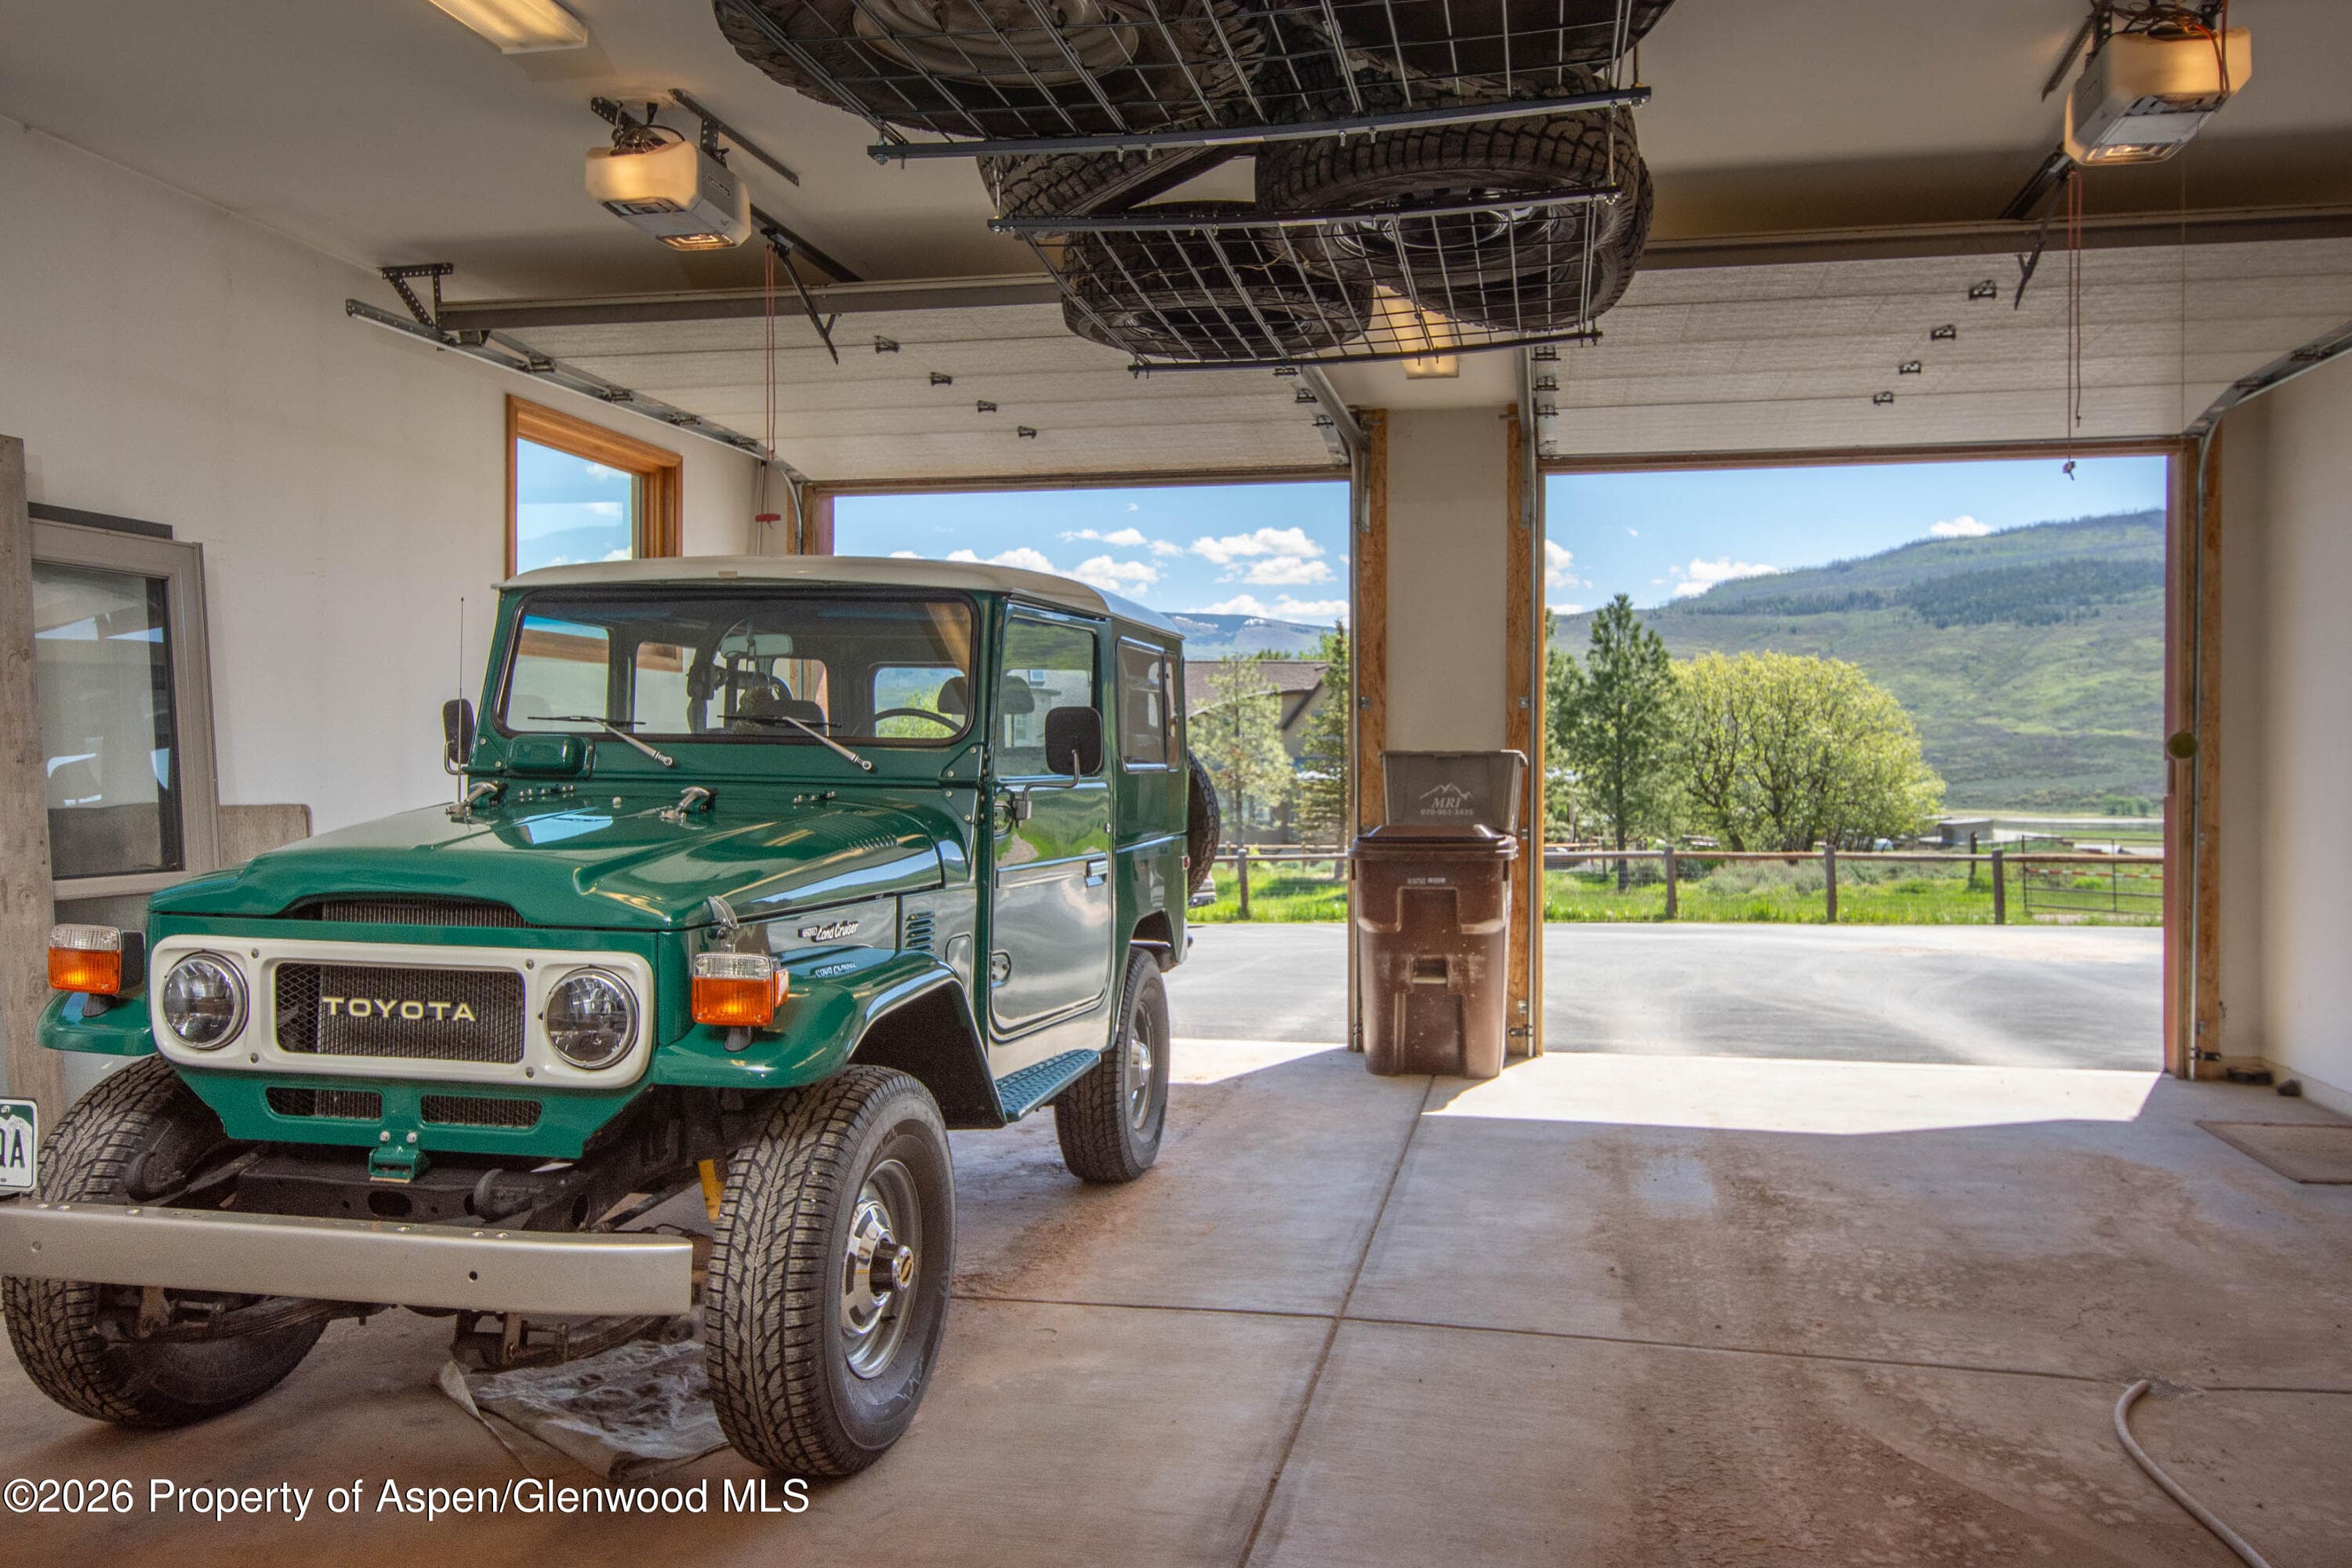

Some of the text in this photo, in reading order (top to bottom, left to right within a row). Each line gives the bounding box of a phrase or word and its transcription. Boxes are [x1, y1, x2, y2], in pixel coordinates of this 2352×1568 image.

[1432, 797, 1461, 808] MRI
[816, 926, 835, 941] Land
[835, 923, 858, 937] Cruiser
[322, 996, 476, 1022] TOYOTA
